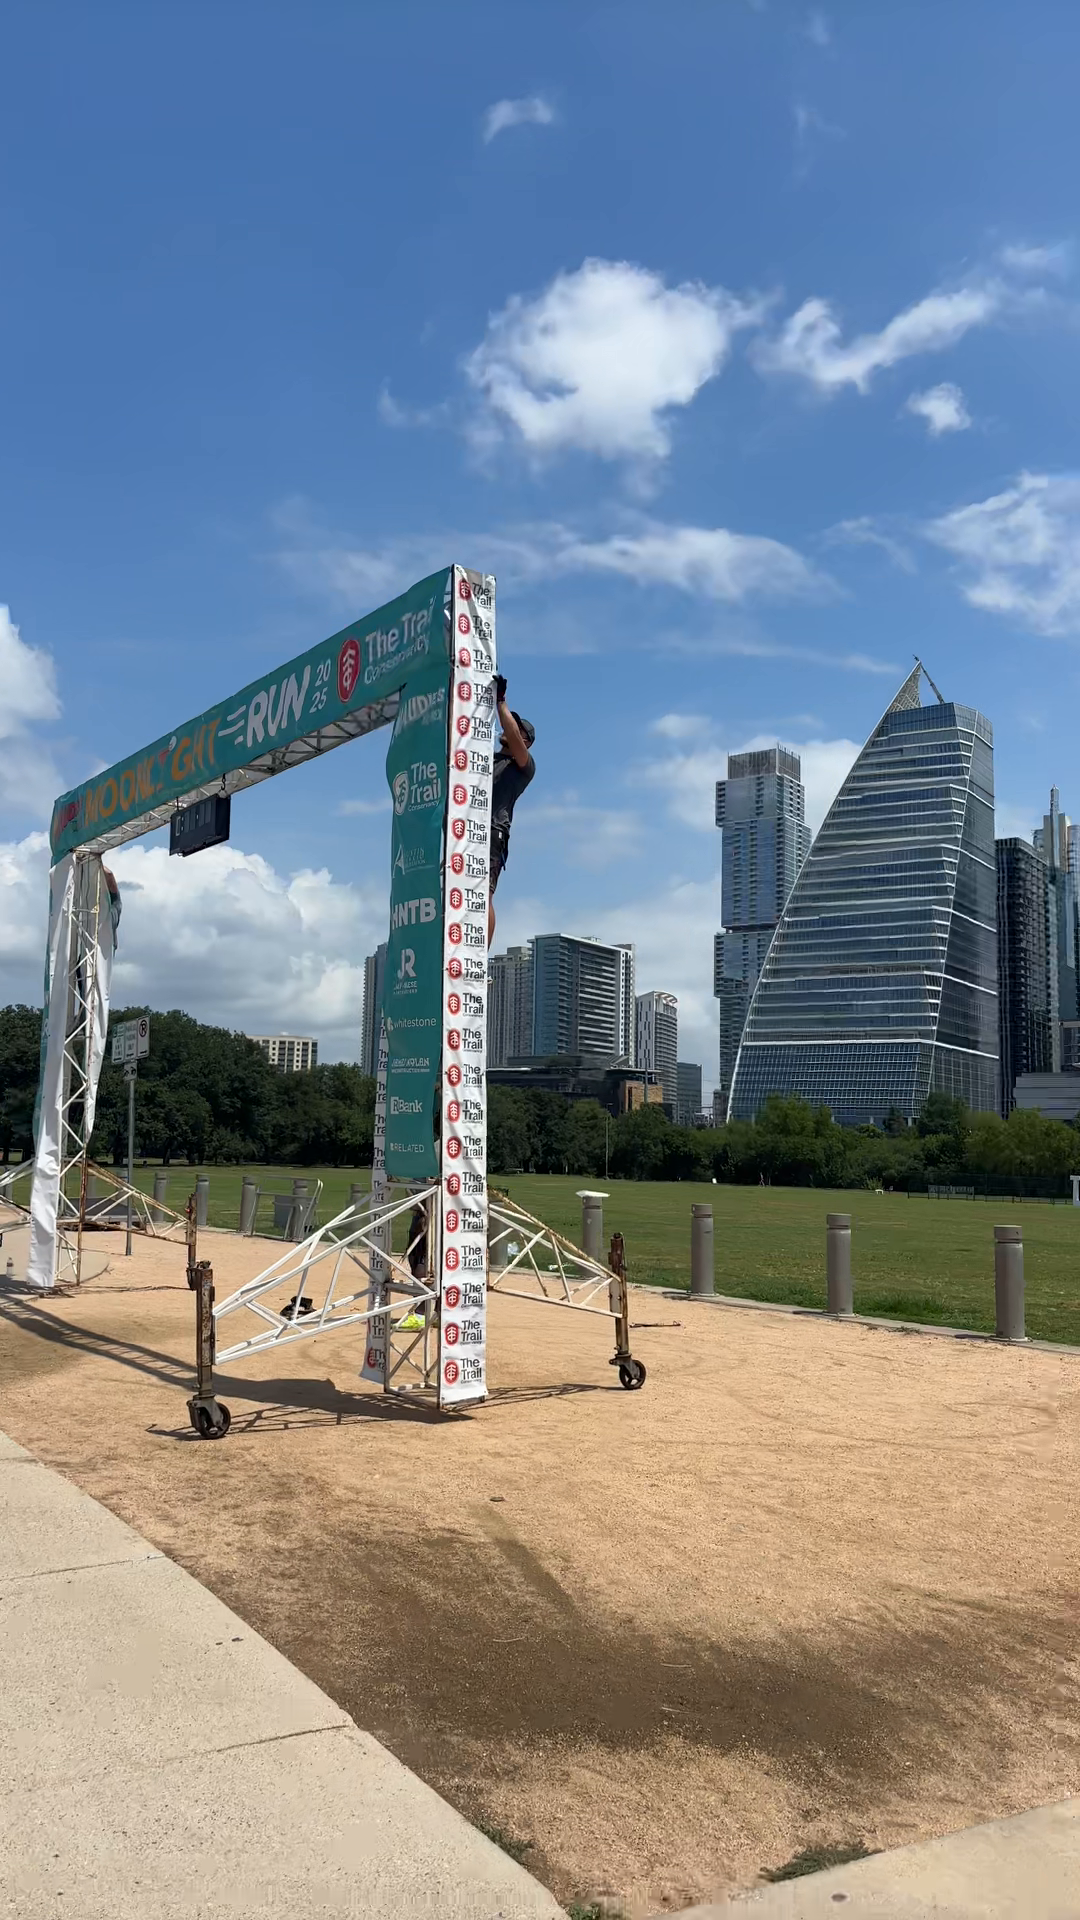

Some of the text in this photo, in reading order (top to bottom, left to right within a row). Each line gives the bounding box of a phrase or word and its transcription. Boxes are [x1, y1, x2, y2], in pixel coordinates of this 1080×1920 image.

[472, 582, 490, 596] The
[366, 628, 399, 664] The
[314, 659, 331, 687] 20
[474, 681, 492, 695] The
[309, 687, 328, 713] 25
[474, 693, 494, 705] Trail
[246, 665, 311, 748] RUN
[472, 716, 490, 729] The
[472, 727, 492, 739] Trail
[470, 751, 489, 763] The
[411, 762, 437, 783] The
[470, 761, 490, 773] Trail
[410, 778, 442, 804] Trail
[470, 785, 487, 797] The
[408, 800, 439, 812] Conservancy
[470, 795, 488, 807] Trail
[467, 819, 486, 831] The
[467, 830, 487, 841] Trail
[466, 854, 485, 866] The
[466, 864, 486, 875] Trail
[465, 889, 484, 900] The
[465, 899, 486, 910] Trail
[391, 897, 437, 930] HNTB
[464, 923, 484, 934] The
[464, 933, 485, 945] Trail
[464, 958, 483, 969] The
[464, 968, 485, 979] Trail
[463, 993, 482, 1004] The
[463, 1003, 483, 1014] Trail
[394, 1017, 437, 1029] whitestone
[463, 1028, 481, 1039] The
[462, 1039, 483, 1049] Trail
[463, 1064, 481, 1074] The
[463, 1073, 483, 1084] Trail
[463, 1099, 481, 1110] The
[462, 1110, 483, 1120] Trail
[463, 1136, 481, 1146] The
[395, 1144, 425, 1152] RELATED
[463, 1146, 483, 1156] Trail
[462, 1172, 482, 1182] The
[462, 1182, 484, 1193] Trail
[461, 1209, 481, 1218] The
[461, 1219, 484, 1230] Trail
[461, 1246, 481, 1255] The
[461, 1256, 483, 1266] Trail
[462, 1283, 481, 1293] The
[462, 1293, 483, 1304] Trail
[461, 1320, 480, 1330] The
[461, 1330, 482, 1341] Trail
[460, 1358, 480, 1368] The
[461, 1368, 482, 1379] Trail
